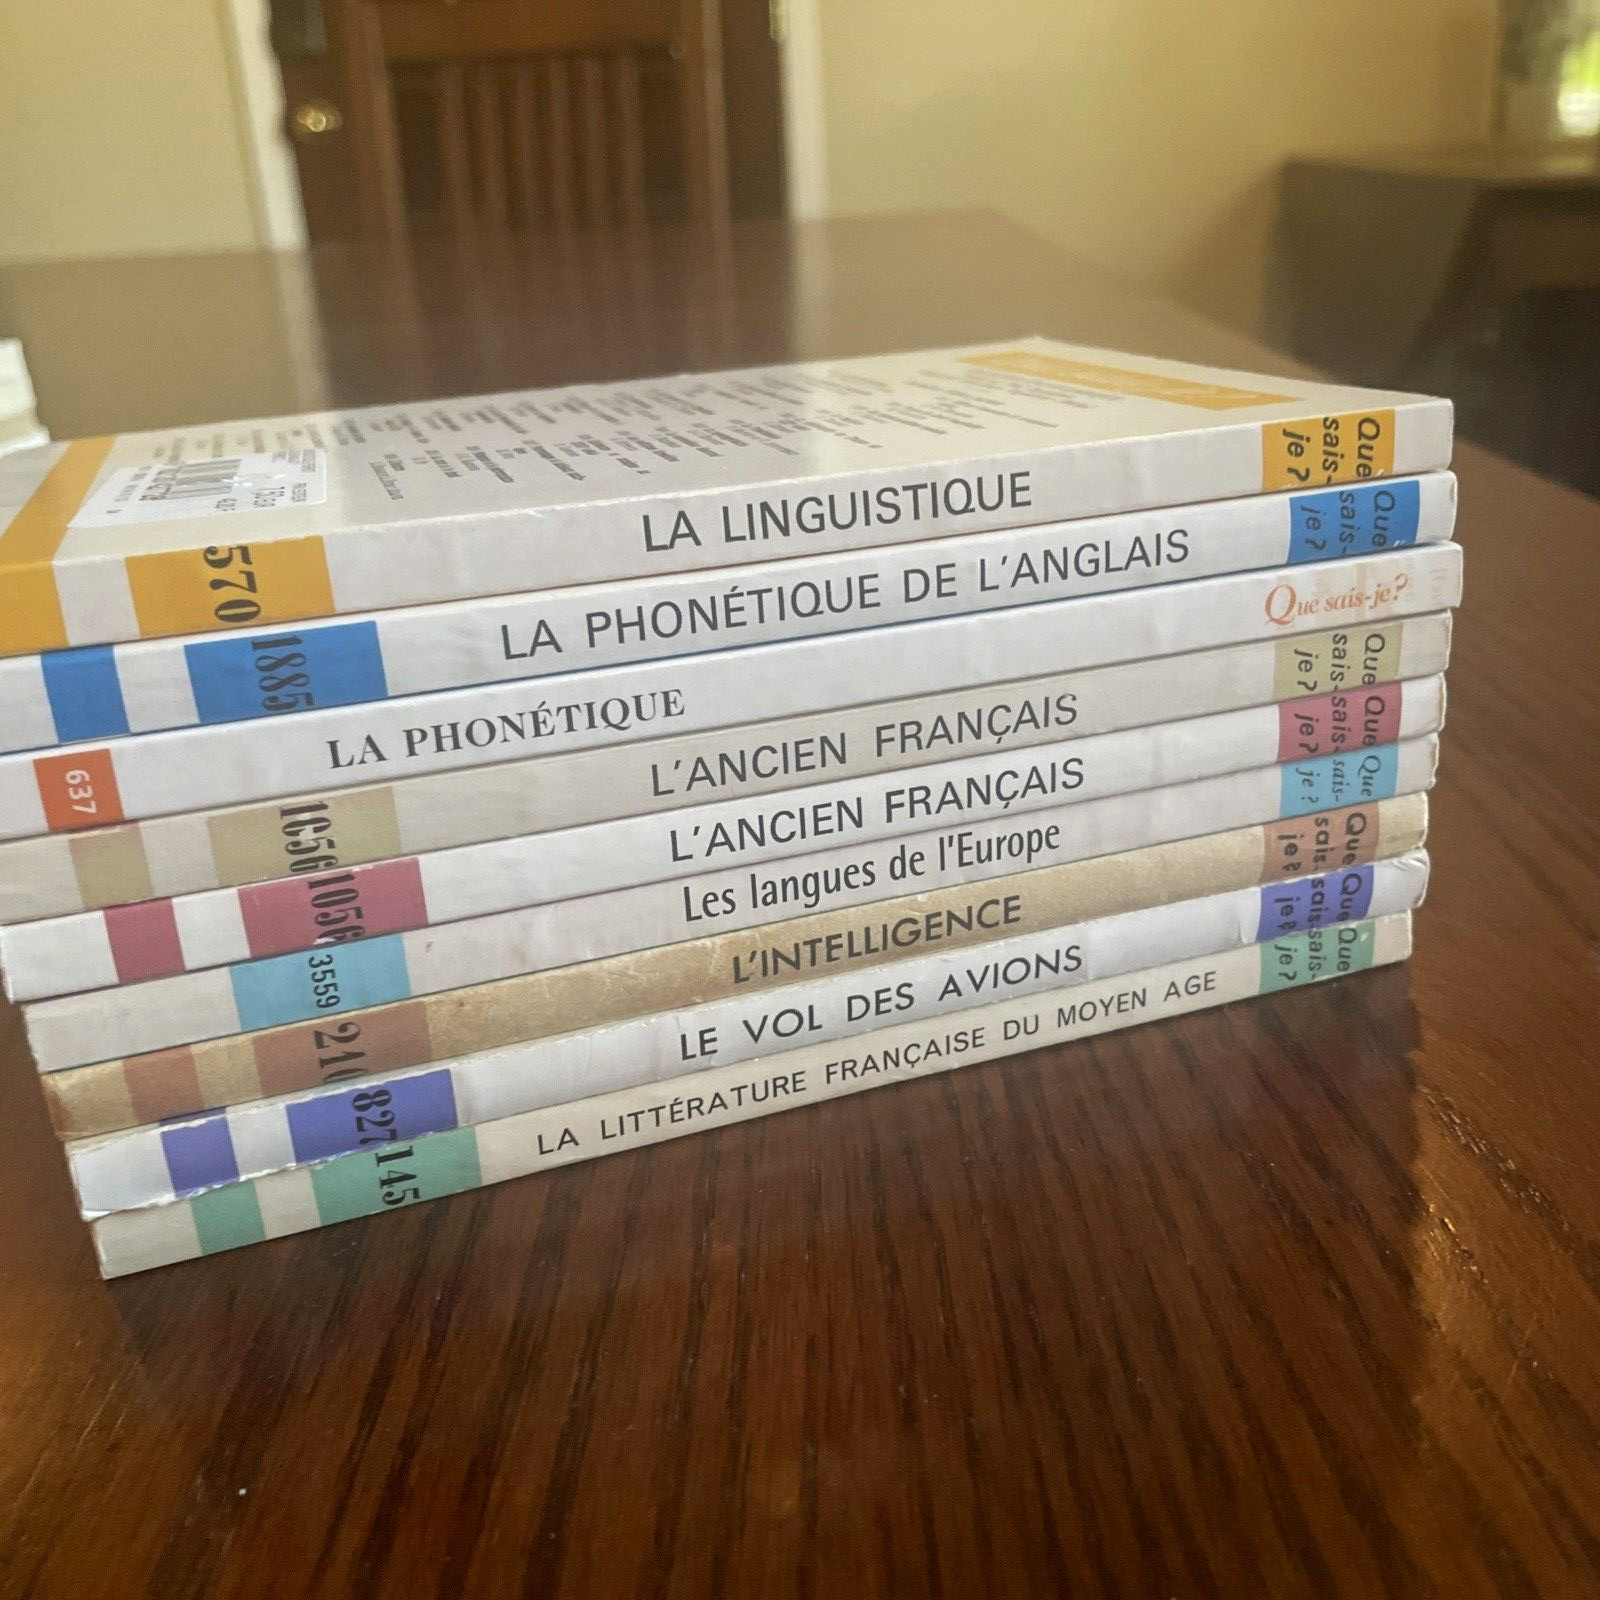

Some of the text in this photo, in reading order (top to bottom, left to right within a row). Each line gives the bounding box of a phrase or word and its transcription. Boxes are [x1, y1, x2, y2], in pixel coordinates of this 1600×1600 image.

[1322, 416, 1344, 484] sais-
[1356, 416, 1380, 477] Que
[642, 471, 1033, 553] LA LINGUISTIQUE
[1339, 490, 1361, 554] sais-
[1372, 490, 1396, 547] Que
[203, 545, 261, 623] 570
[501, 529, 1190, 660] LA PHONÉTIQUE DE L'ANGLAIS
[1264, 583, 1320, 627] Que
[251, 635, 314, 711] 1885
[1329, 633, 1351, 692] sais-
[1362, 633, 1386, 686] Que
[326, 688, 685, 769] LA PHONÉTIQUE
[651, 693, 1078, 797] L'ANCIEN FRANÇAIS
[1331, 696, 1351, 754] sais-
[1362, 695, 1386, 747] Que
[65, 768, 97, 815] 637
[1332, 759, 1350, 802] sais-
[1357, 755, 1382, 797] Que
[671, 758, 1085, 862] L'ANCIEN FRANÇAIS
[1342, 812, 1367, 865] Que
[1314, 816, 1335, 871] sais-
[683, 824, 1061, 922] Les langues de l'Europe
[1336, 873, 1362, 922] Que
[1308, 877, 1329, 928] sais-
[732, 894, 1023, 985] L'INTELLIGENCE
[1308, 927, 1327, 979] sais-
[1336, 927, 1358, 972] Que
[308, 954, 341, 1009] 3559
[680, 945, 1083, 1061] LE VOL DES AVIONS
[537, 971, 1218, 1156] LA LITTÉRATURE FRANÇAISE DU MOYEN AGE
[352, 1089, 399, 1146] 827
[375, 1145, 421, 1206] 145
